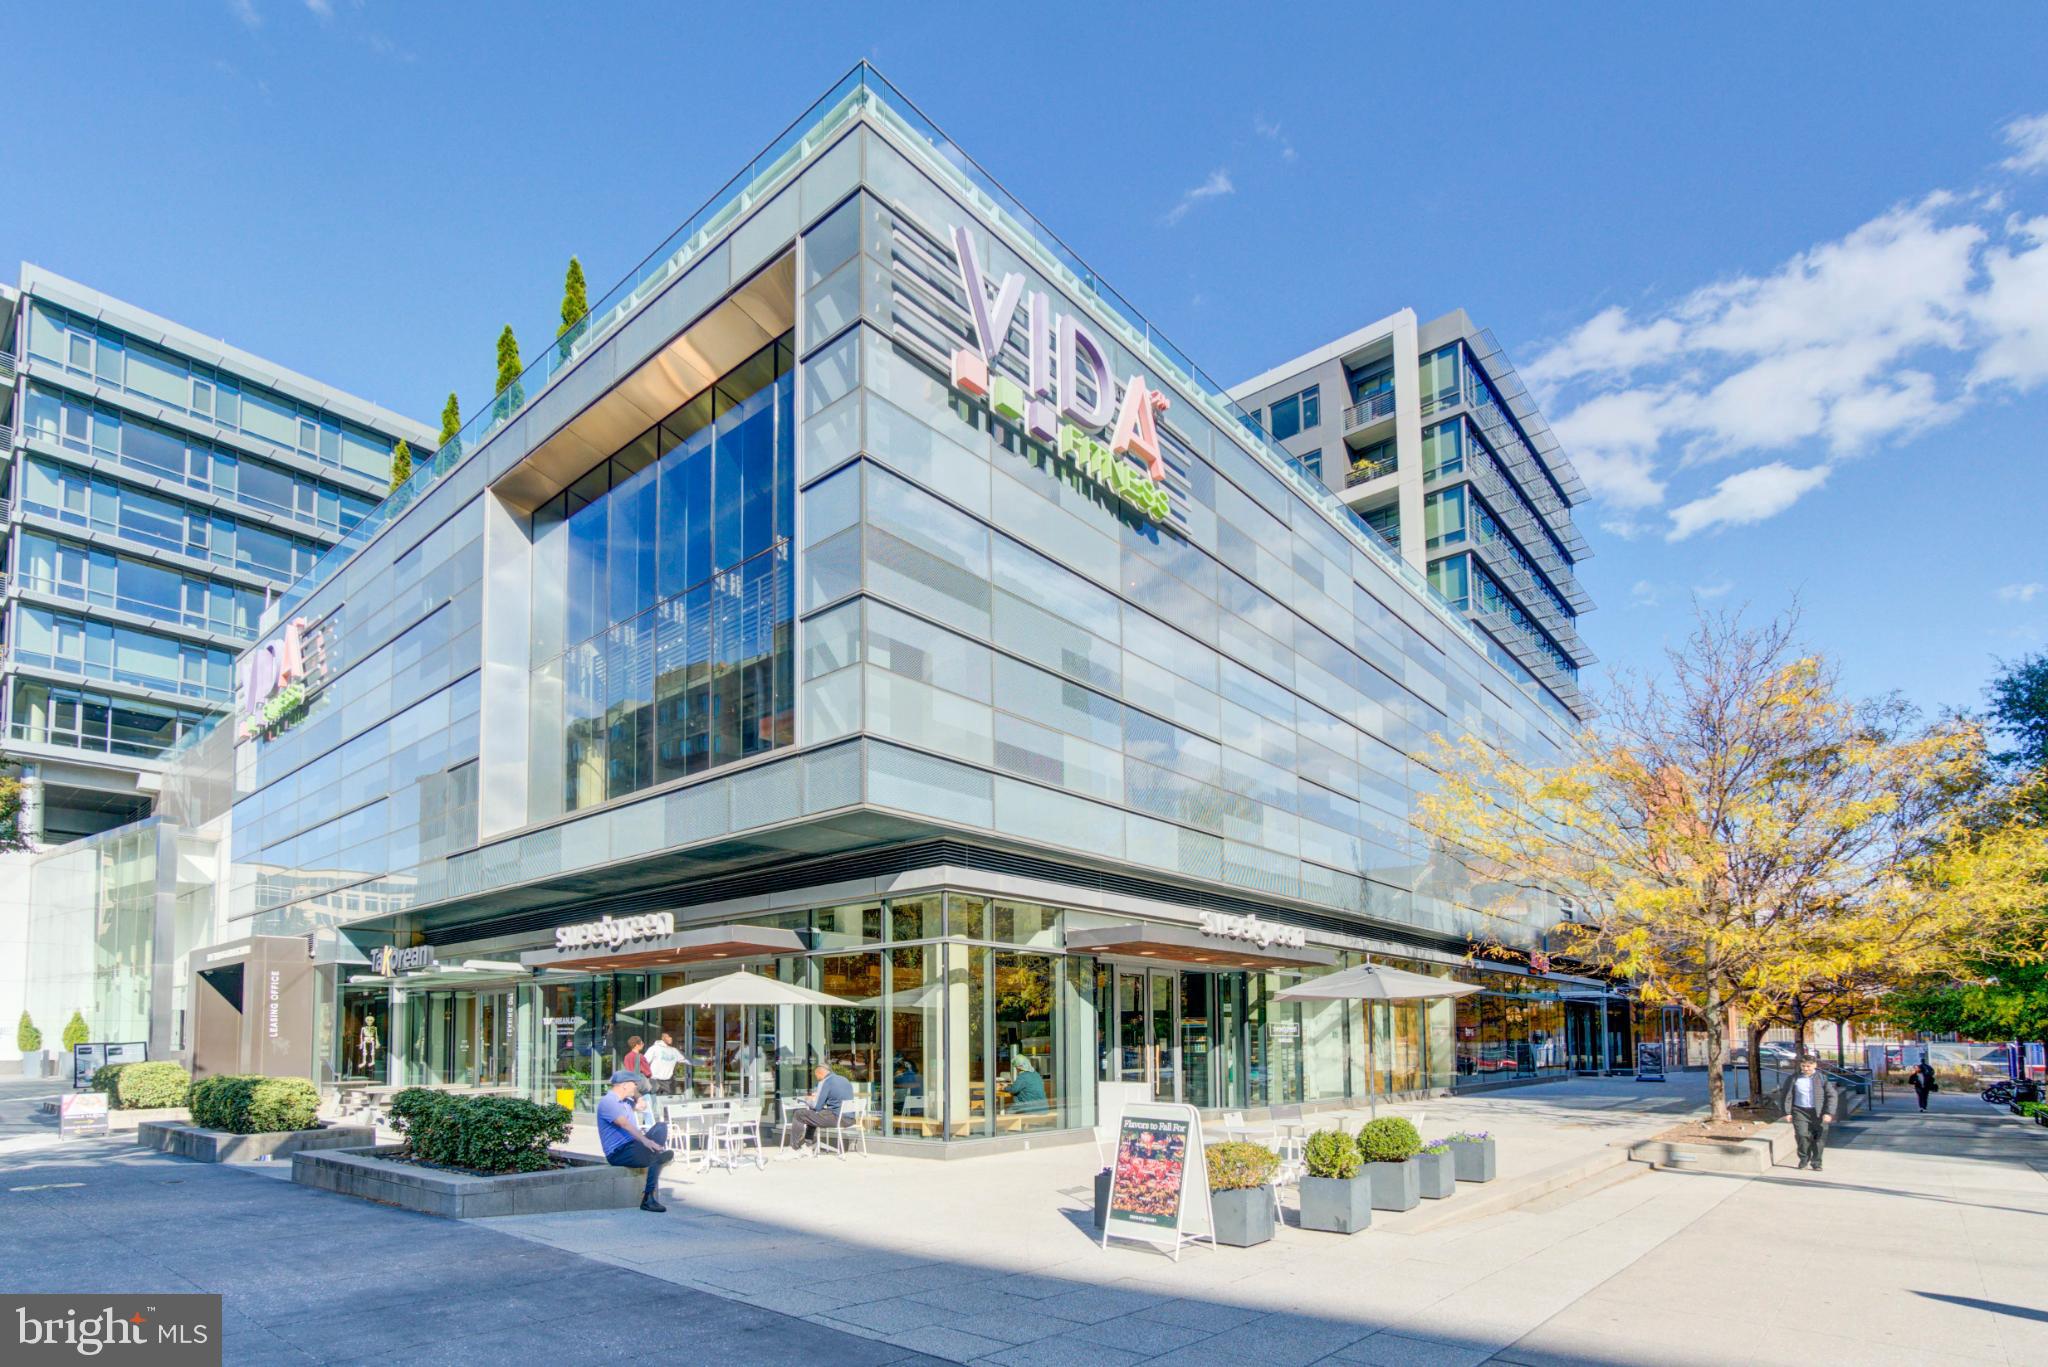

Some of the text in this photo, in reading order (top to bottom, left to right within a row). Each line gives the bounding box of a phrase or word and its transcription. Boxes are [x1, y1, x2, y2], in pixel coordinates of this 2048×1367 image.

[948, 224, 1166, 482] VIDA
[1059, 424, 1170, 523] FITNESS
[555, 912, 674, 947] sweetgreen
[1199, 911, 1305, 947] sweetgreen
[370, 945, 431, 977] TaKorean
[269, 970, 280, 1038] LEASING OFFICE
[1123, 1120, 1149, 1130] Flavors
[1158, 1122, 1172, 1132] Fall
[1172, 1123, 1186, 1132] For
